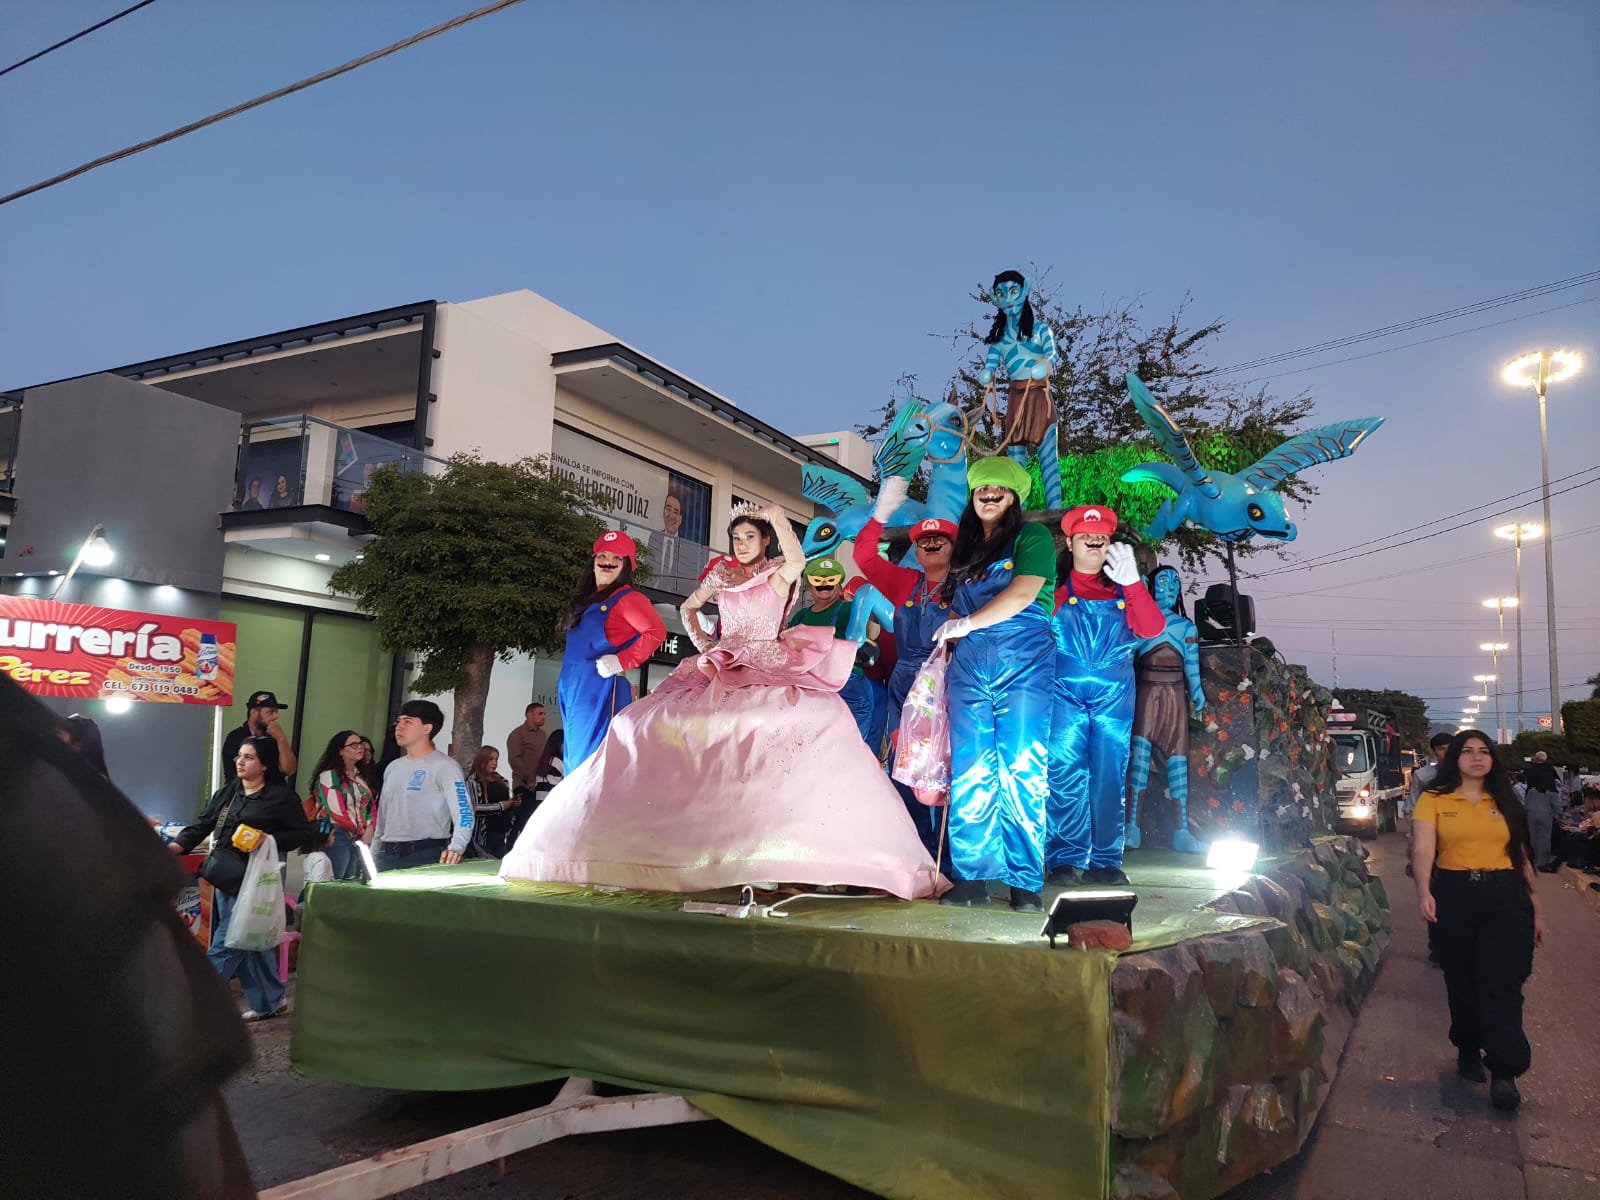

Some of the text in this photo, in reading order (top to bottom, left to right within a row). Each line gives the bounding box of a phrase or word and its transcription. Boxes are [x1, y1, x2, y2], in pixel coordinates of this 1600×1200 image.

[551, 453, 635, 491] SINALOA SE INFORMA CON
[627, 490, 649, 519] DÍAZ
[128, 663, 181, 674] Desde 1950
[104, 681, 199, 694] CEL. 673 119 0483
